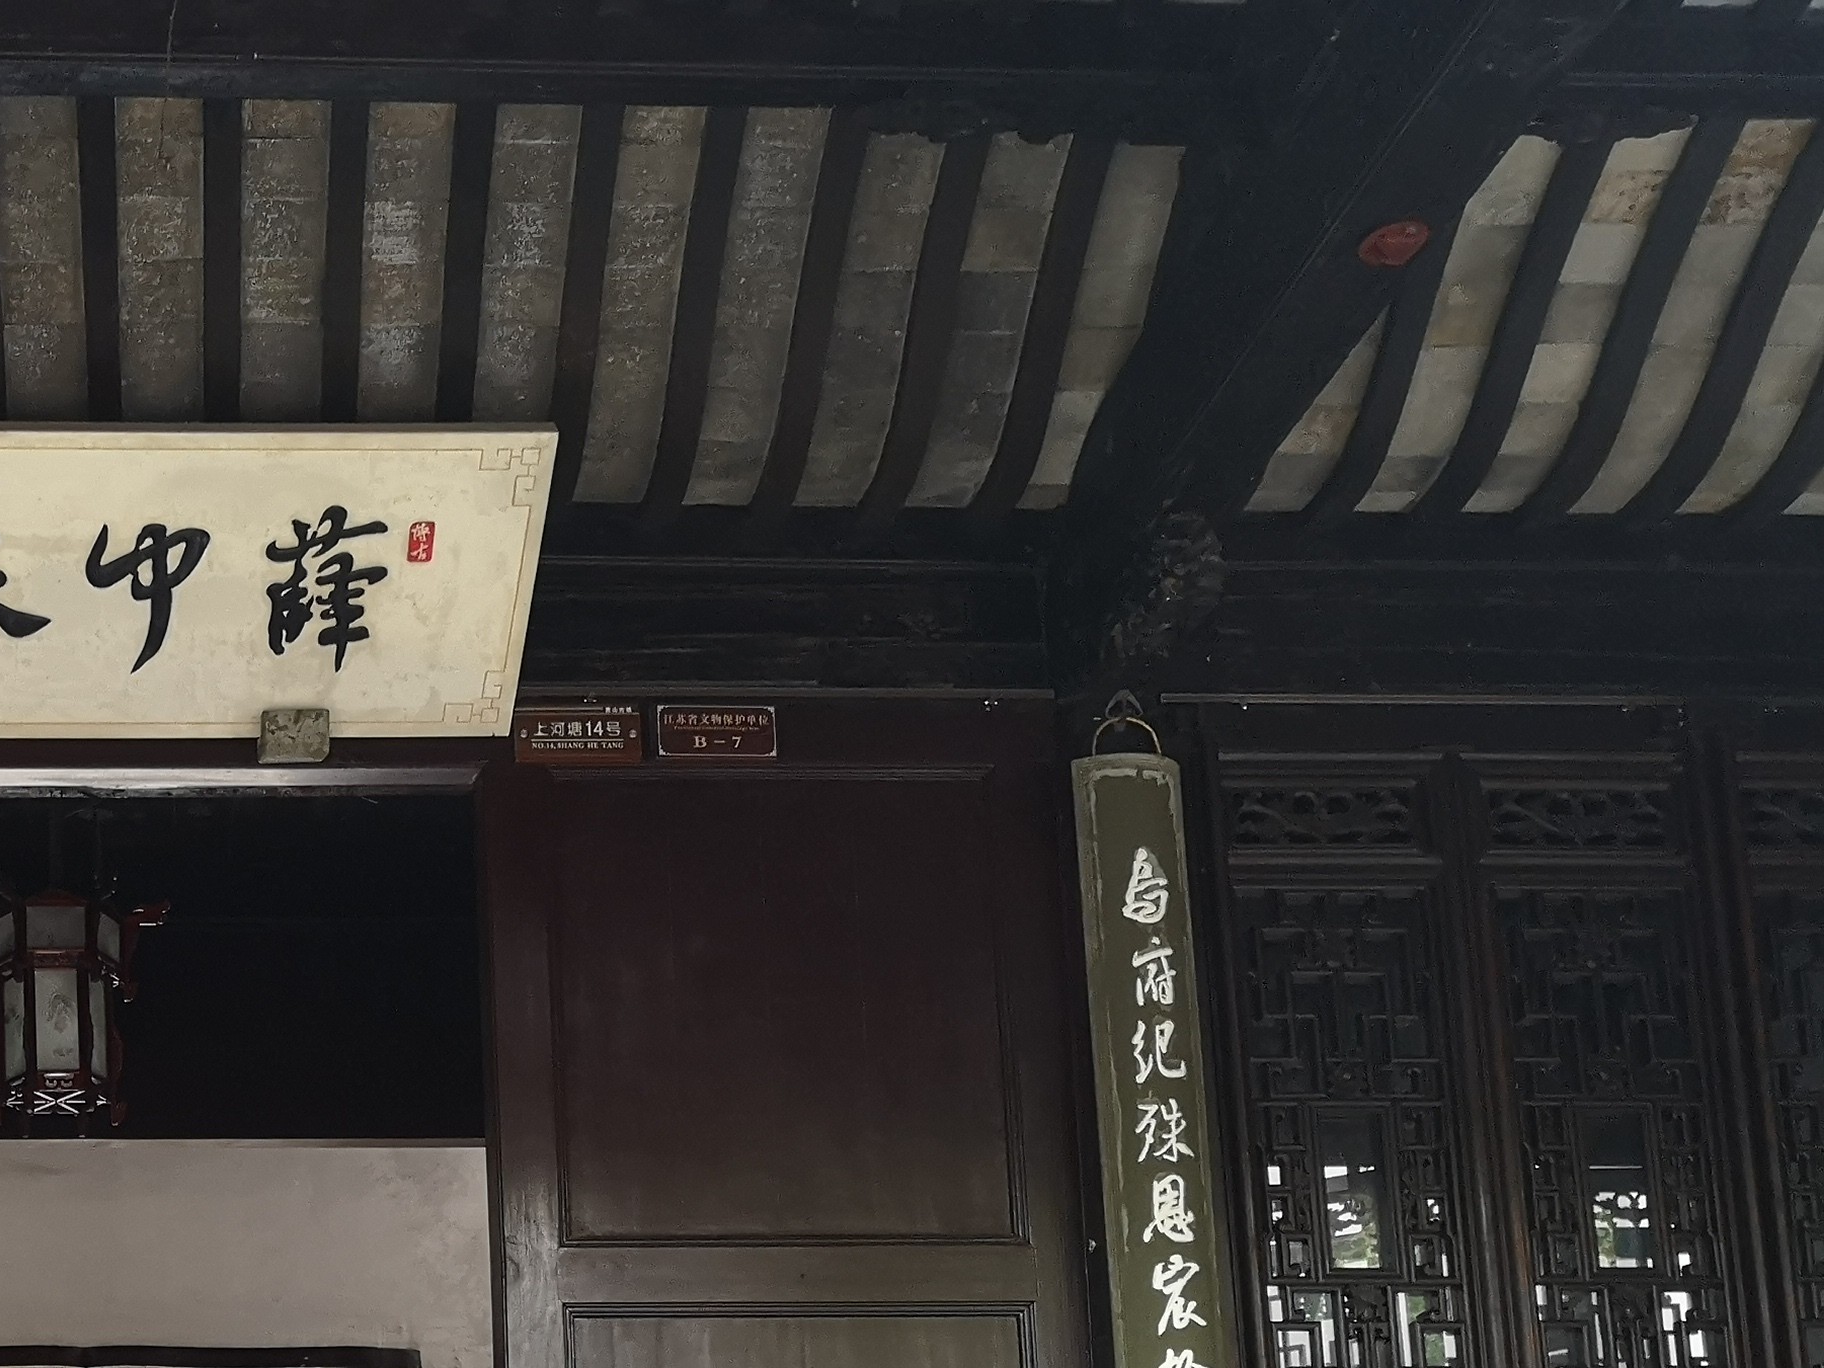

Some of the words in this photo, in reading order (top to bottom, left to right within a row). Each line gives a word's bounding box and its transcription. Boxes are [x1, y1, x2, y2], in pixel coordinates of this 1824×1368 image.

[663, 713, 770, 726] 江苏省文物保护单位
[533, 720, 621, 737] 上河塘14号
